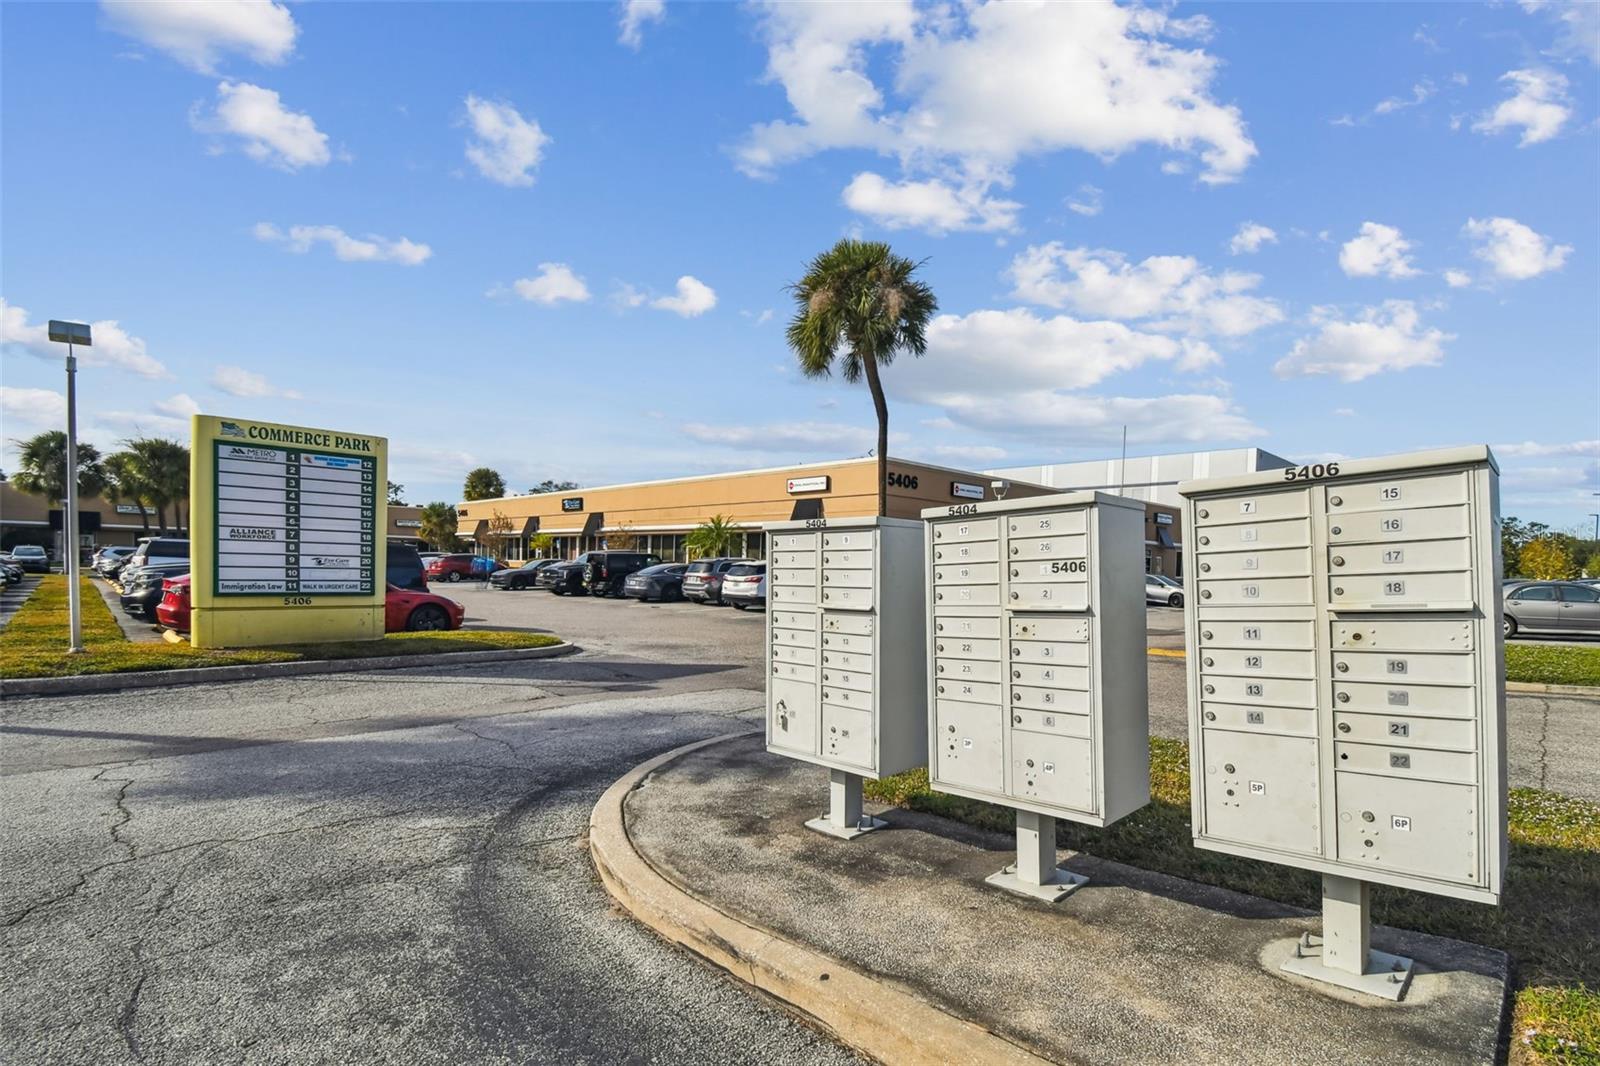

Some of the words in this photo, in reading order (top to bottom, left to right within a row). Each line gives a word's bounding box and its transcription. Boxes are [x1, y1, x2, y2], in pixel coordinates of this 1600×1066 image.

[249, 425, 330, 447] COMMERCE
[335, 434, 371, 452] PARK
[247, 448, 277, 458] METRO
[362, 461, 373, 469] 12
[1284, 462, 1340, 482] 5406
[887, 472, 919, 490] 5406
[1382, 487, 1399, 499] 15
[948, 503, 978, 517] 5404
[1243, 502, 1251, 513] 7
[805, 519, 827, 528] 5404
[1383, 519, 1400, 531] 16
[229, 528, 276, 536] ALLIANCE
[1385, 550, 1401, 562] 17
[1051, 561, 1087, 573] 5406
[221, 583, 266, 591] Immigration
[1244, 586, 1256, 596] 10
[1386, 582, 1402, 594] 18
[284, 597, 312, 606] 5406
[1245, 629, 1258, 639] 11
[1246, 656, 1259, 667] 12
[1389, 661, 1405, 673] 19
[1247, 685, 1260, 695] 13
[1248, 712, 1261, 722] 14
[1391, 724, 1408, 735] 21
[1390, 755, 1408, 767] 22
[1252, 783, 1263, 793] 5P
[1394, 819, 1408, 829] 6P
